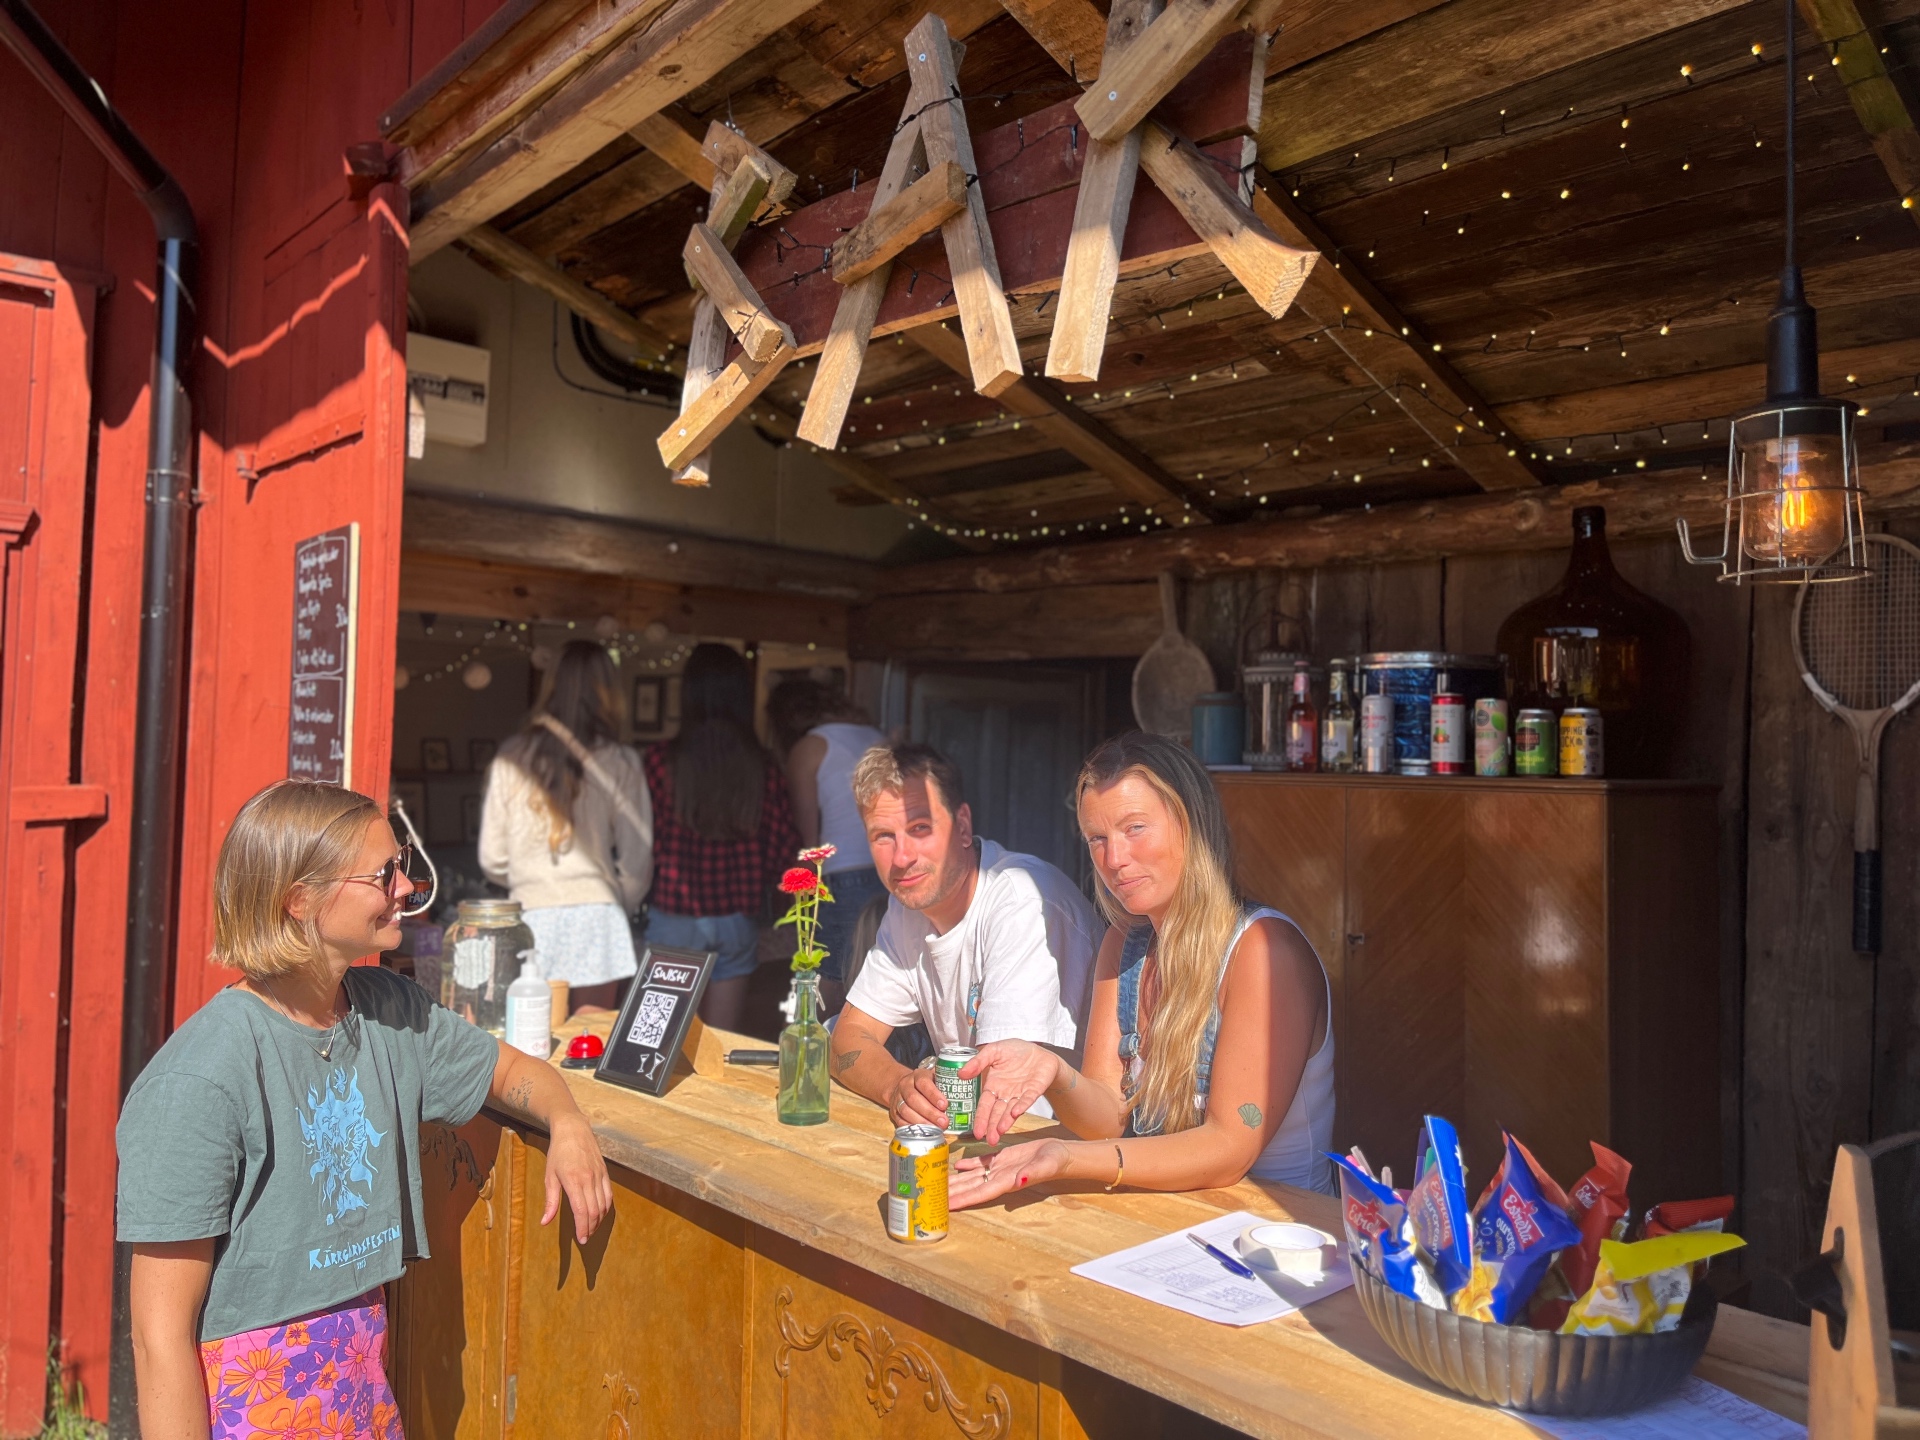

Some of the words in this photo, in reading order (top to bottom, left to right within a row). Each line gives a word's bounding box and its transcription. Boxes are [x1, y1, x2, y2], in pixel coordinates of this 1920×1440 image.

[656, 0, 1320, 488] BAR
[653, 966, 690, 984] SWISH!
[941, 1077, 973, 1085] PROBABLY
[952, 1085, 973, 1093] BEER
[1503, 1194, 1532, 1244] Estrella
